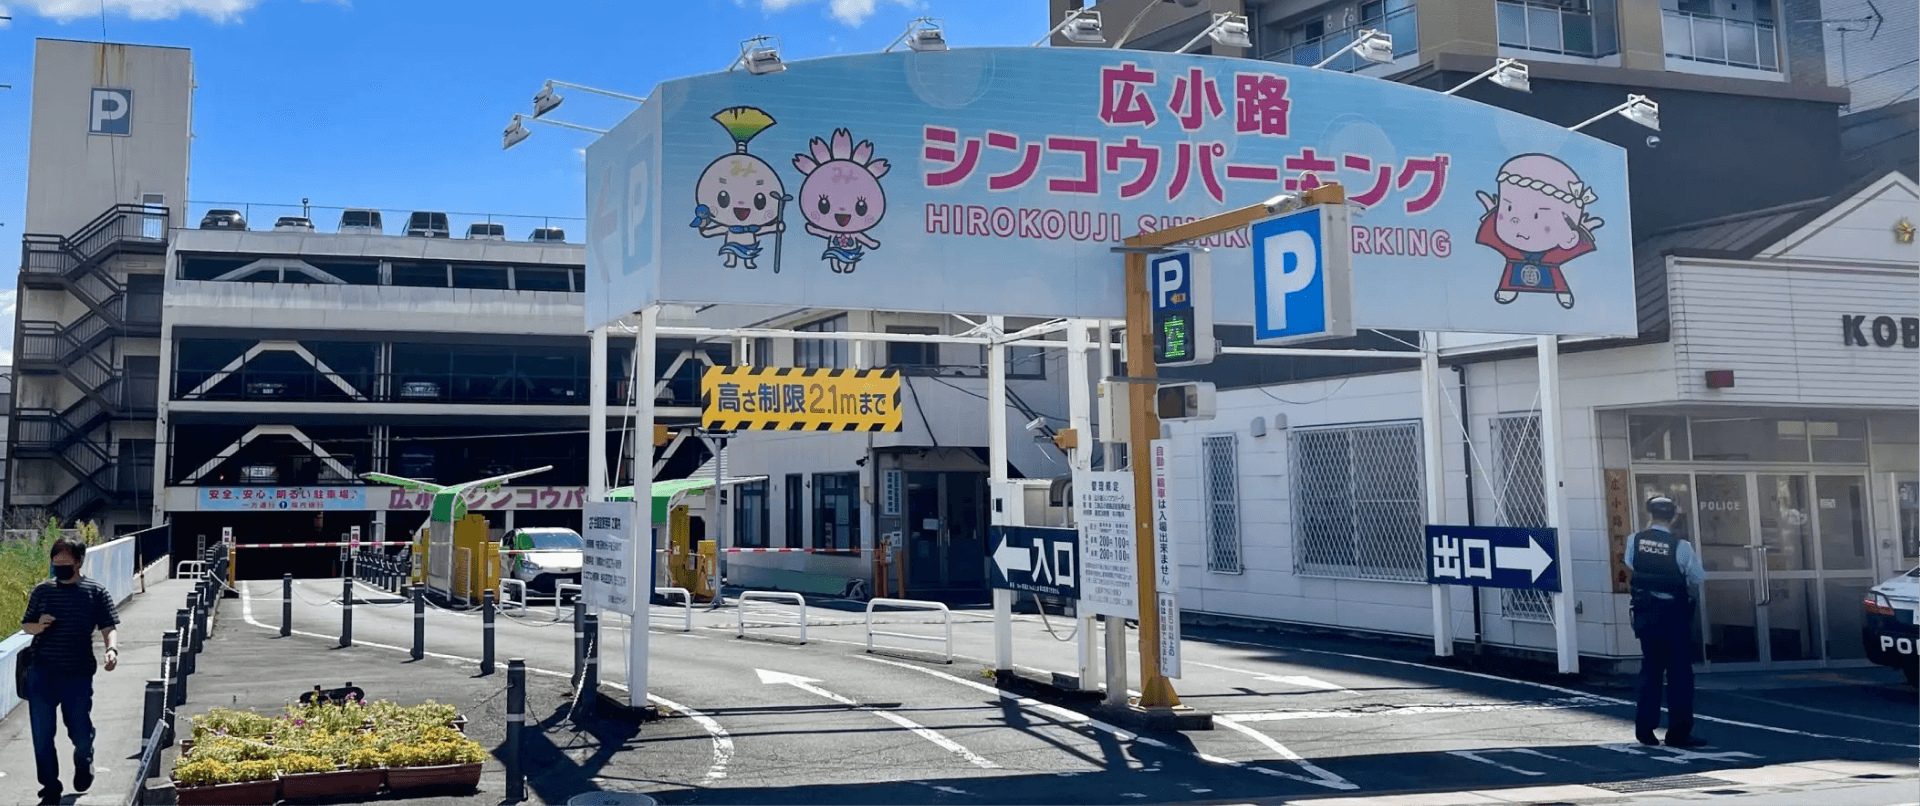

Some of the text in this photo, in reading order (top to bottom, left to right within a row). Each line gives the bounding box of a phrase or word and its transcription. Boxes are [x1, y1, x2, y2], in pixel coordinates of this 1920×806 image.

[92, 90, 128, 131] P
[1101, 64, 1290, 136] 広小路
[924, 124, 1450, 214] シンコウパーキング
[628, 161, 648, 257] P
[925, 203, 1121, 242] HIROKOUJI
[1158, 259, 1183, 308] P
[1264, 230, 1316, 330] P
[1164, 316, 1186, 358] 空
[1842, 314, 1919, 348] KOB
[717, 382, 887, 415] 高さ制限2.1mまで
[1700, 501, 1741, 511] POLICE
[1031, 537, 1075, 588] 入口
[1432, 534, 1492, 580] 出口
[1639, 545, 1669, 556] POLICE
[1880, 635, 1919, 656] PO
